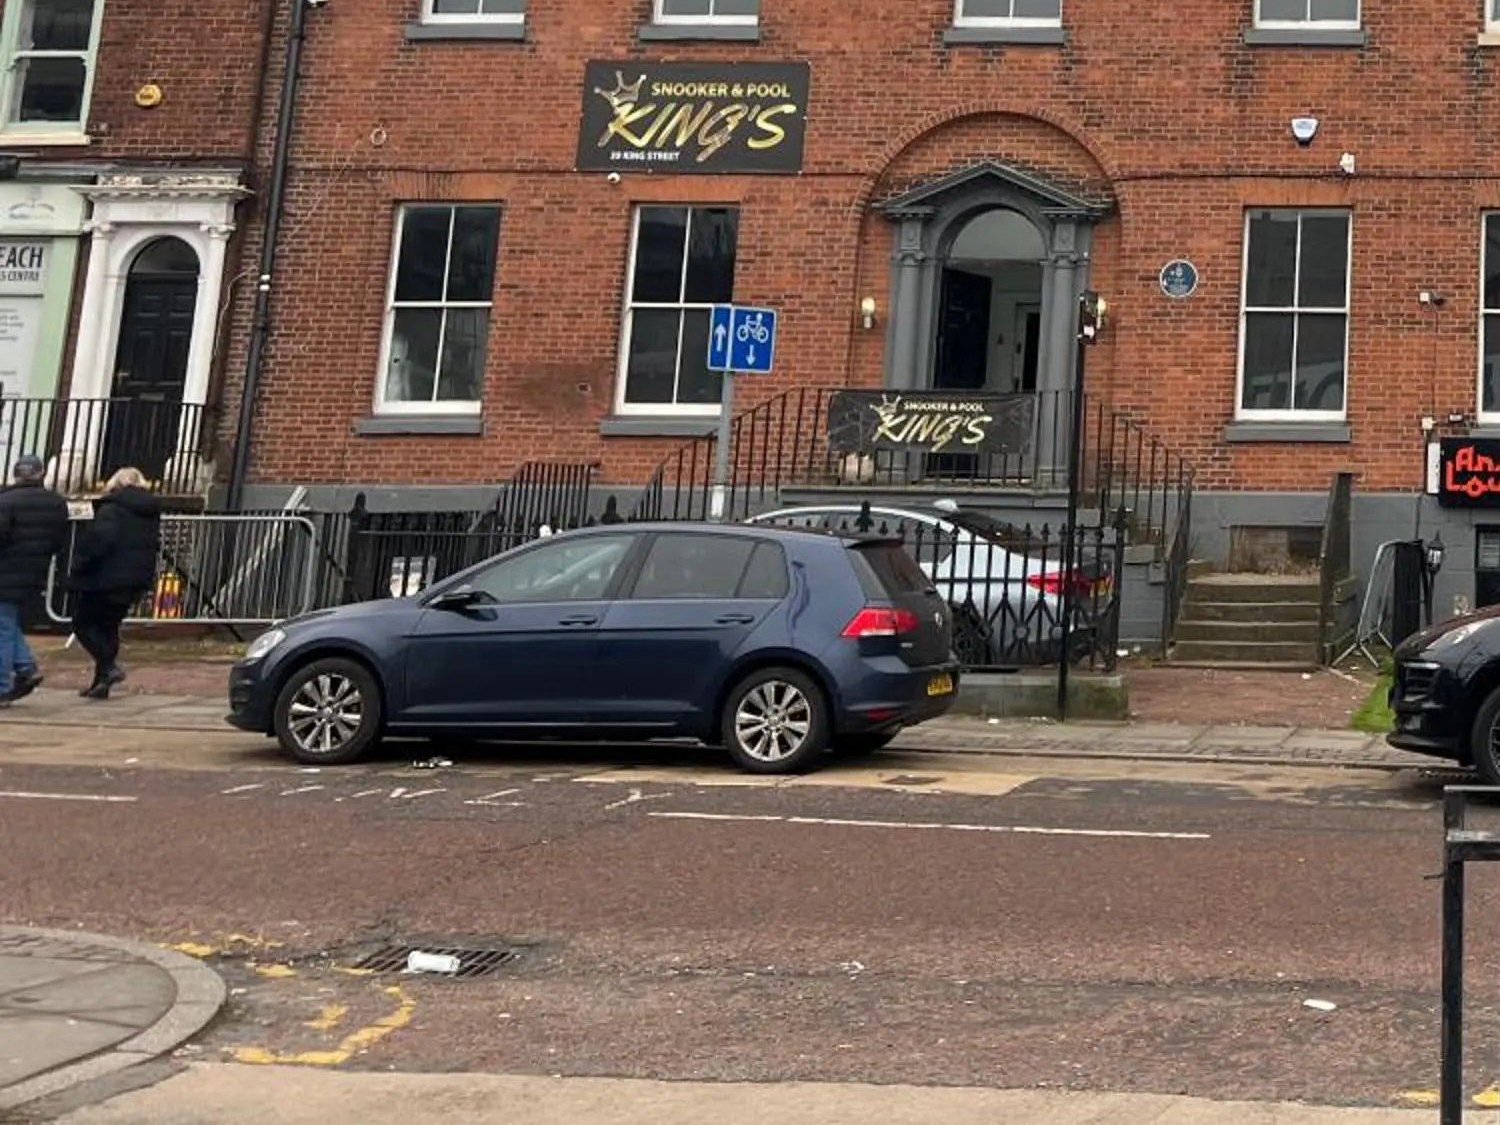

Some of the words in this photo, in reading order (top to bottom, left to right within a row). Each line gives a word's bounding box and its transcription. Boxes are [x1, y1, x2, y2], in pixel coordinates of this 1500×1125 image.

[651, 82, 728, 97] SNOOKER
[731, 83, 743, 97] &
[747, 83, 791, 98] POOL
[597, 101, 797, 163] KING'S
[904, 402, 948, 411] SNOOKER
[958, 403, 985, 412] POOL
[871, 414, 993, 452] KING'S
